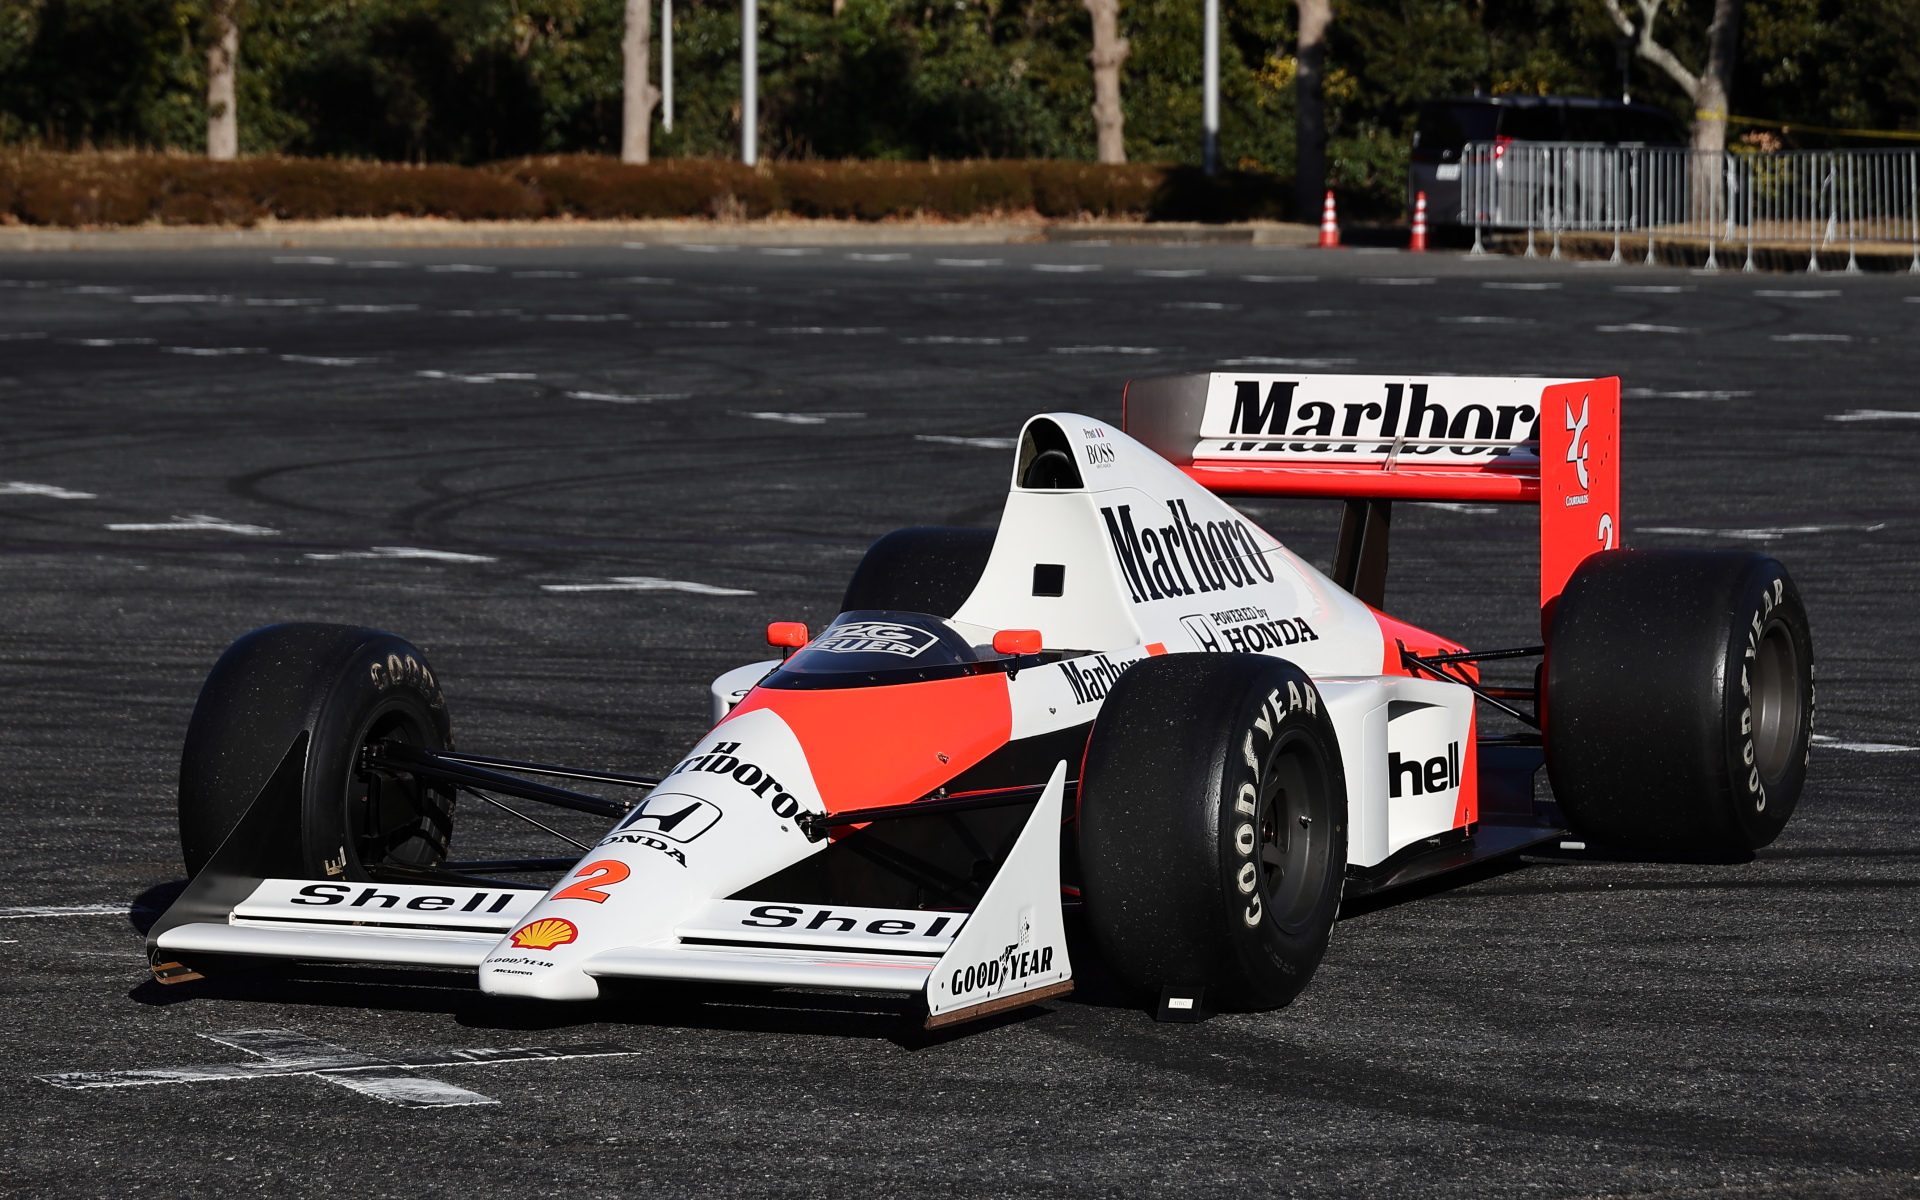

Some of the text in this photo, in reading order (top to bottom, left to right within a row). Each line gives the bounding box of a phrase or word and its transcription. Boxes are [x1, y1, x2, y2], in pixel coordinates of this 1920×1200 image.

[1219, 381, 1541, 456] Marlbor
[1085, 442, 1115, 465] BOSS
[1100, 498, 1275, 604] Marlboro
[1209, 606, 1270, 626] POWERED by
[1221, 616, 1320, 654] HONDA
[670, 742, 799, 819] rlboro
[1388, 740, 1460, 799] hell
[597, 834, 688, 869] ONDA
[290, 884, 515, 914] Shell
[550, 859, 631, 904] 2
